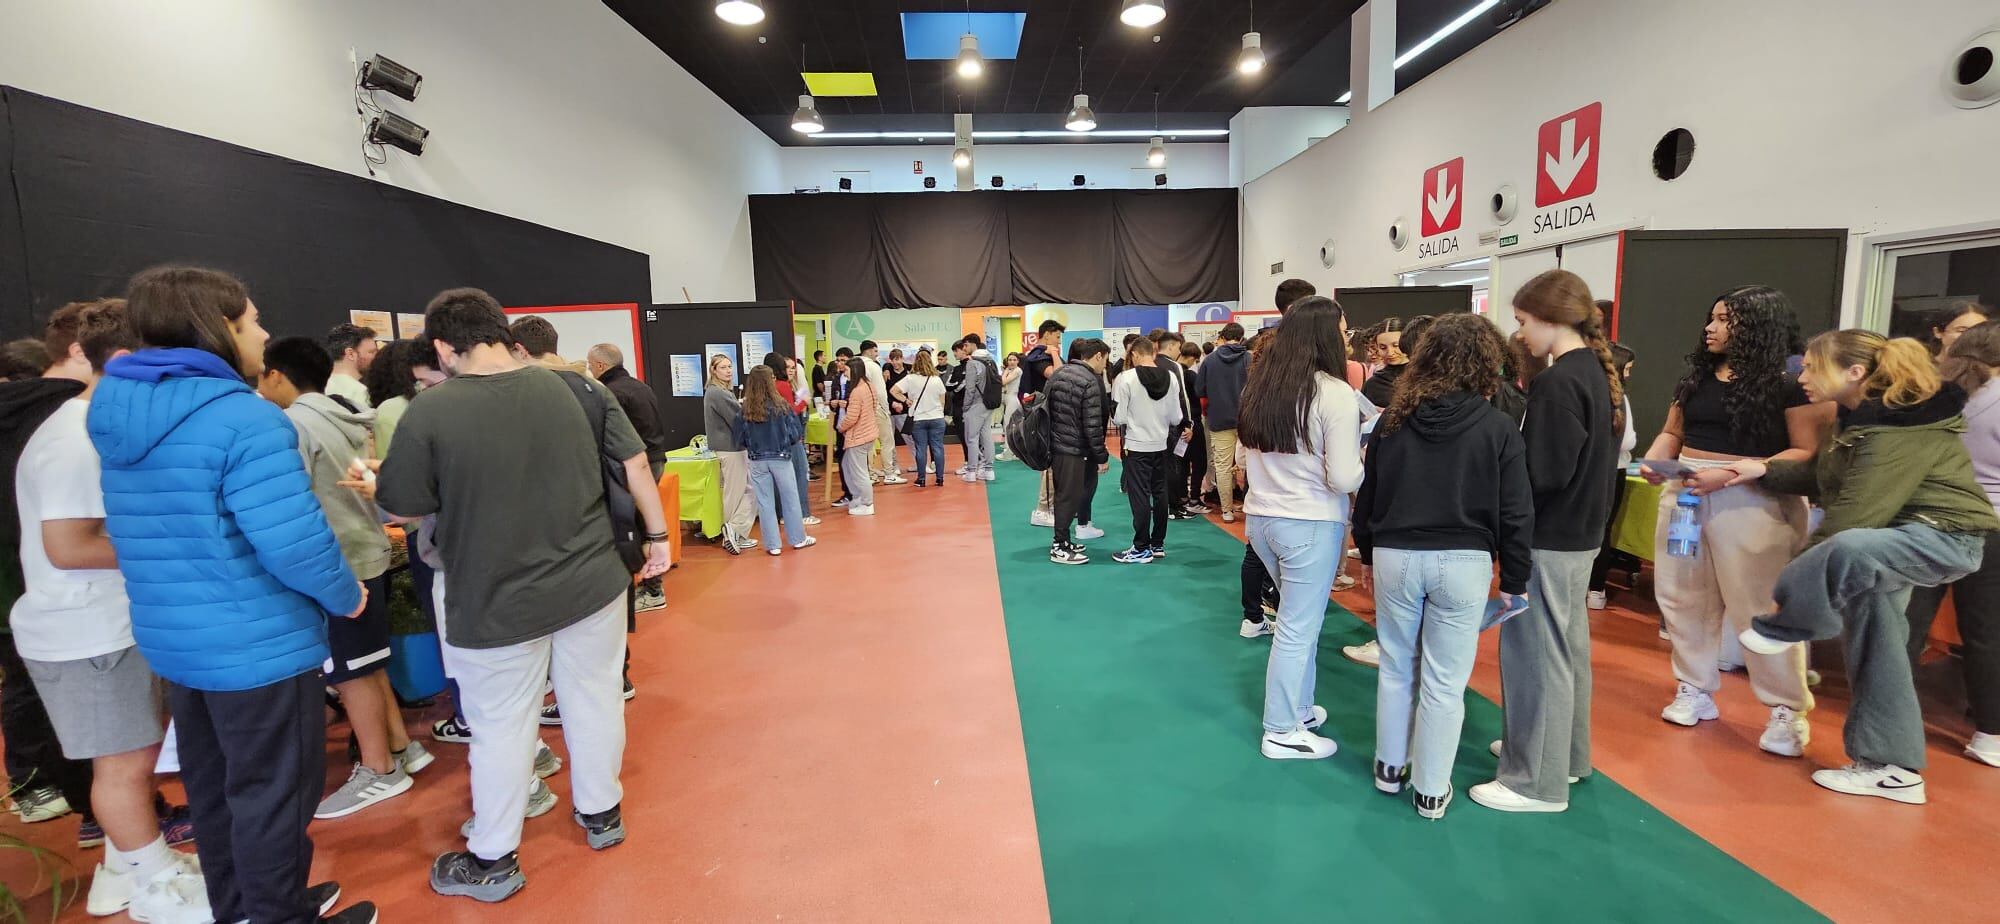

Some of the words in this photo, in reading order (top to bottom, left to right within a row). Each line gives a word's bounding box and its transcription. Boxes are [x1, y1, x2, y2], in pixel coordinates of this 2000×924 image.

[1533, 202, 1596, 234] SALIDA
[1418, 235, 1460, 260] SALIDA
[846, 315, 867, 336] A
